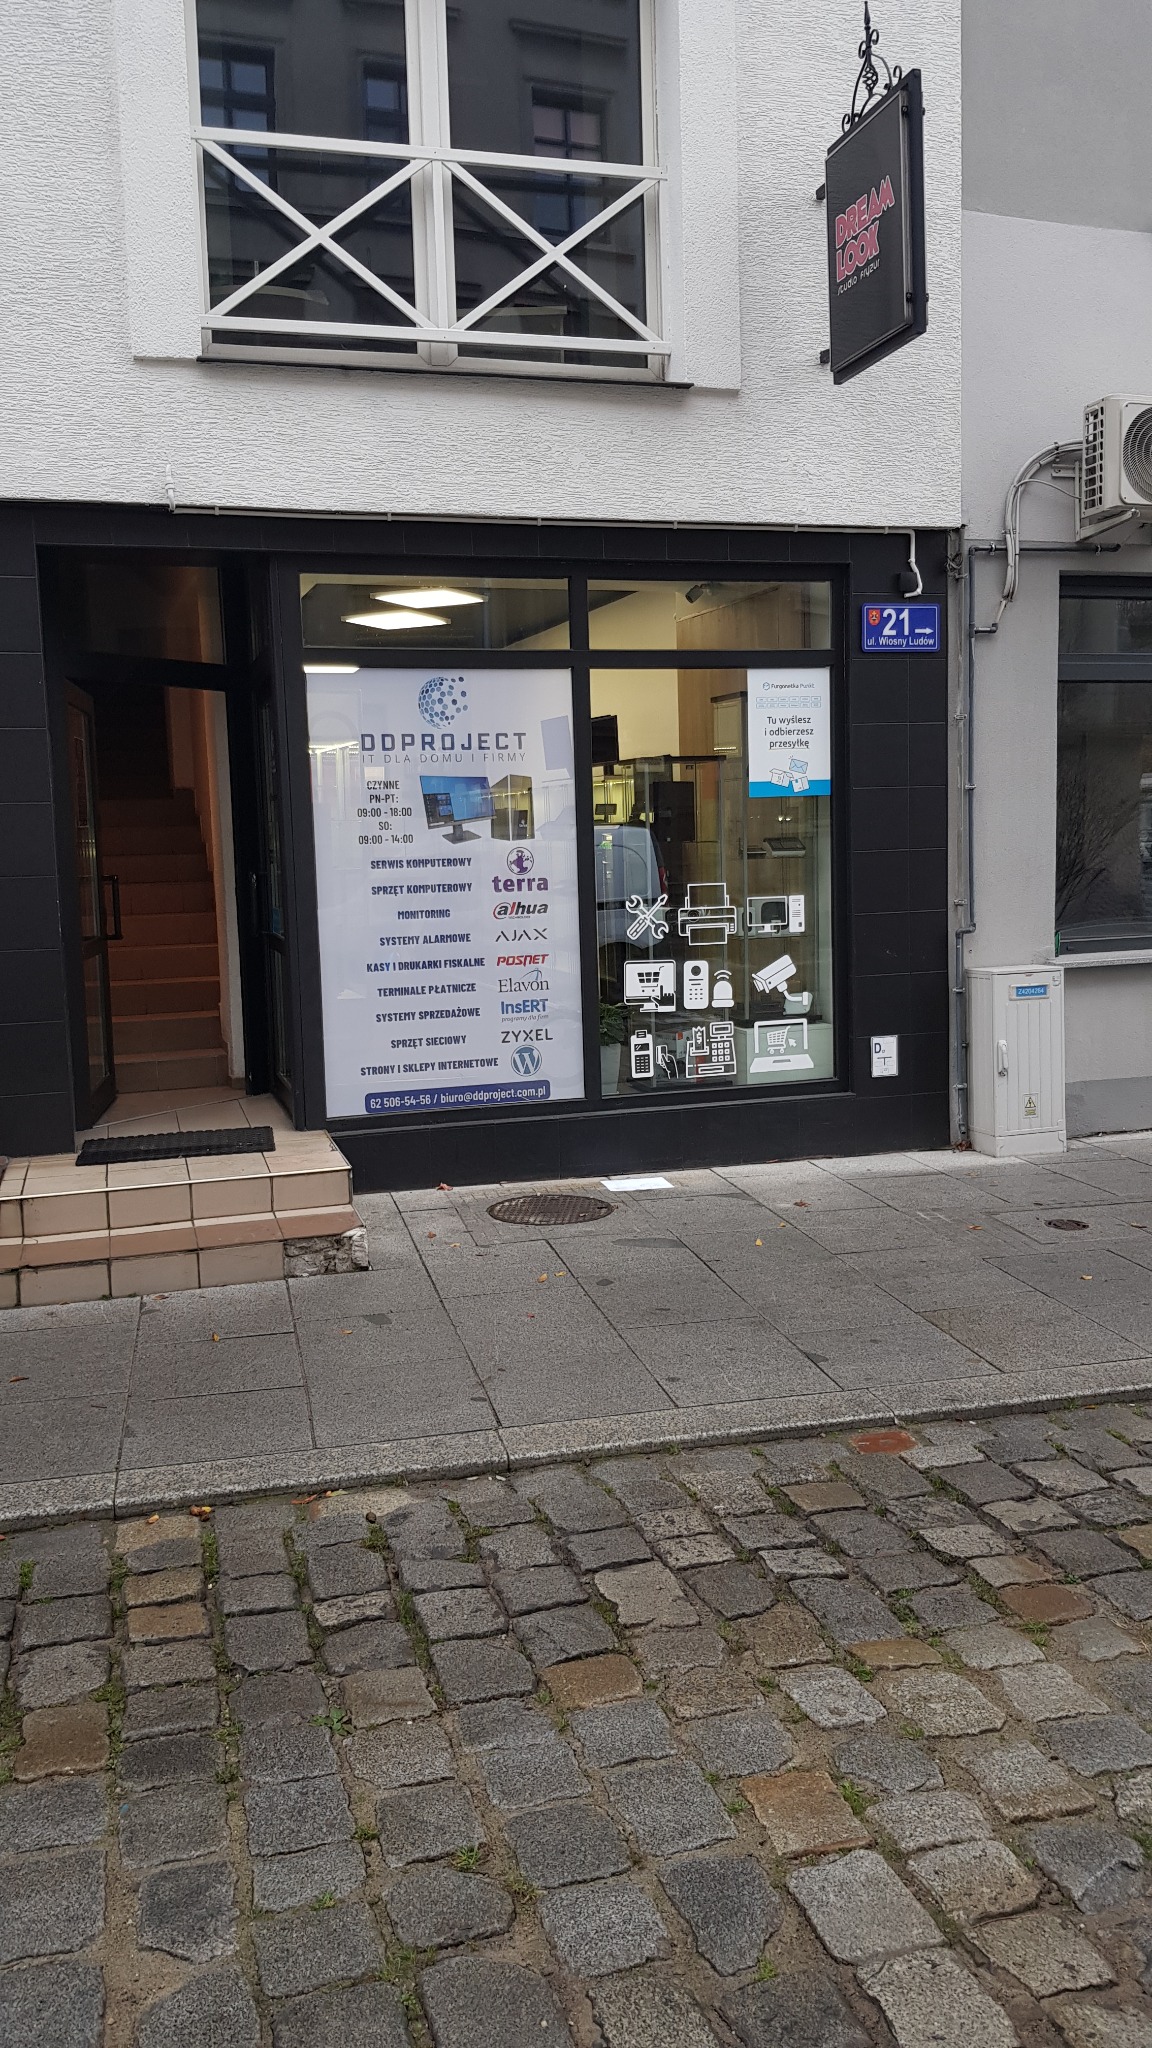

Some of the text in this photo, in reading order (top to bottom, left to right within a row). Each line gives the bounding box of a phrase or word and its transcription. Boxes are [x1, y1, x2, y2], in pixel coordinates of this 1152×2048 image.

[835, 175, 895, 249] DREAM
[836, 220, 880, 283] LOOK
[882, 608, 909, 636] 21
[867, 636, 935, 648] ul. Wiosny Ludów
[767, 715, 812, 726] Tu wyślesz
[769, 727, 814, 736] odbierzesz
[360, 732, 527, 752] DDPROJECT
[769, 739, 810, 750] przesyłkę
[362, 754, 374, 764] IT
[384, 754, 411, 763] DLA
[420, 753, 463, 763] DOMU
[483, 752, 526, 762] FIRMY
[366, 780, 400, 790] CZYNNE
[369, 793, 399, 804] PN-PT:
[357, 807, 382, 818] 09:00
[389, 807, 412, 817] 18:00
[378, 821, 393, 831] SO:
[358, 835, 383, 845] 09:00
[390, 834, 414, 844] 14:00
[370, 857, 472, 870] SERWIS KOMPUTEROWY
[371, 882, 473, 897] SPRZĘT KOMPUTEROWY
[492, 875, 549, 893] terra
[397, 908, 451, 920] MONITORING
[379, 933, 472, 947] SYSTEMY ALARMOWE
[495, 927, 548, 942] AJAX
[366, 962, 391, 973] KASY
[398, 959, 442, 971] DRUKARKI
[443, 957, 486, 969] FISKALNE
[377, 982, 477, 998] TERMINALE PŁATNICZE
[498, 977, 550, 994] Elavon
[500, 998, 549, 1015] InsERT
[375, 1006, 481, 1023] SYSTEMY SPRZEDAŻOWE
[390, 1034, 467, 1050] SPRZĘT SIECIOWY
[500, 1028, 554, 1044] ZYXEL
[360, 1065, 396, 1077] STRONY
[402, 1062, 436, 1074] SKLEPY
[437, 1057, 499, 1071] INTERNETOWE
[370, 1098, 382, 1109] 62
[383, 1094, 431, 1108] 506-54-56
[440, 1085, 546, 1103] biuro@ddproject.com.pl
